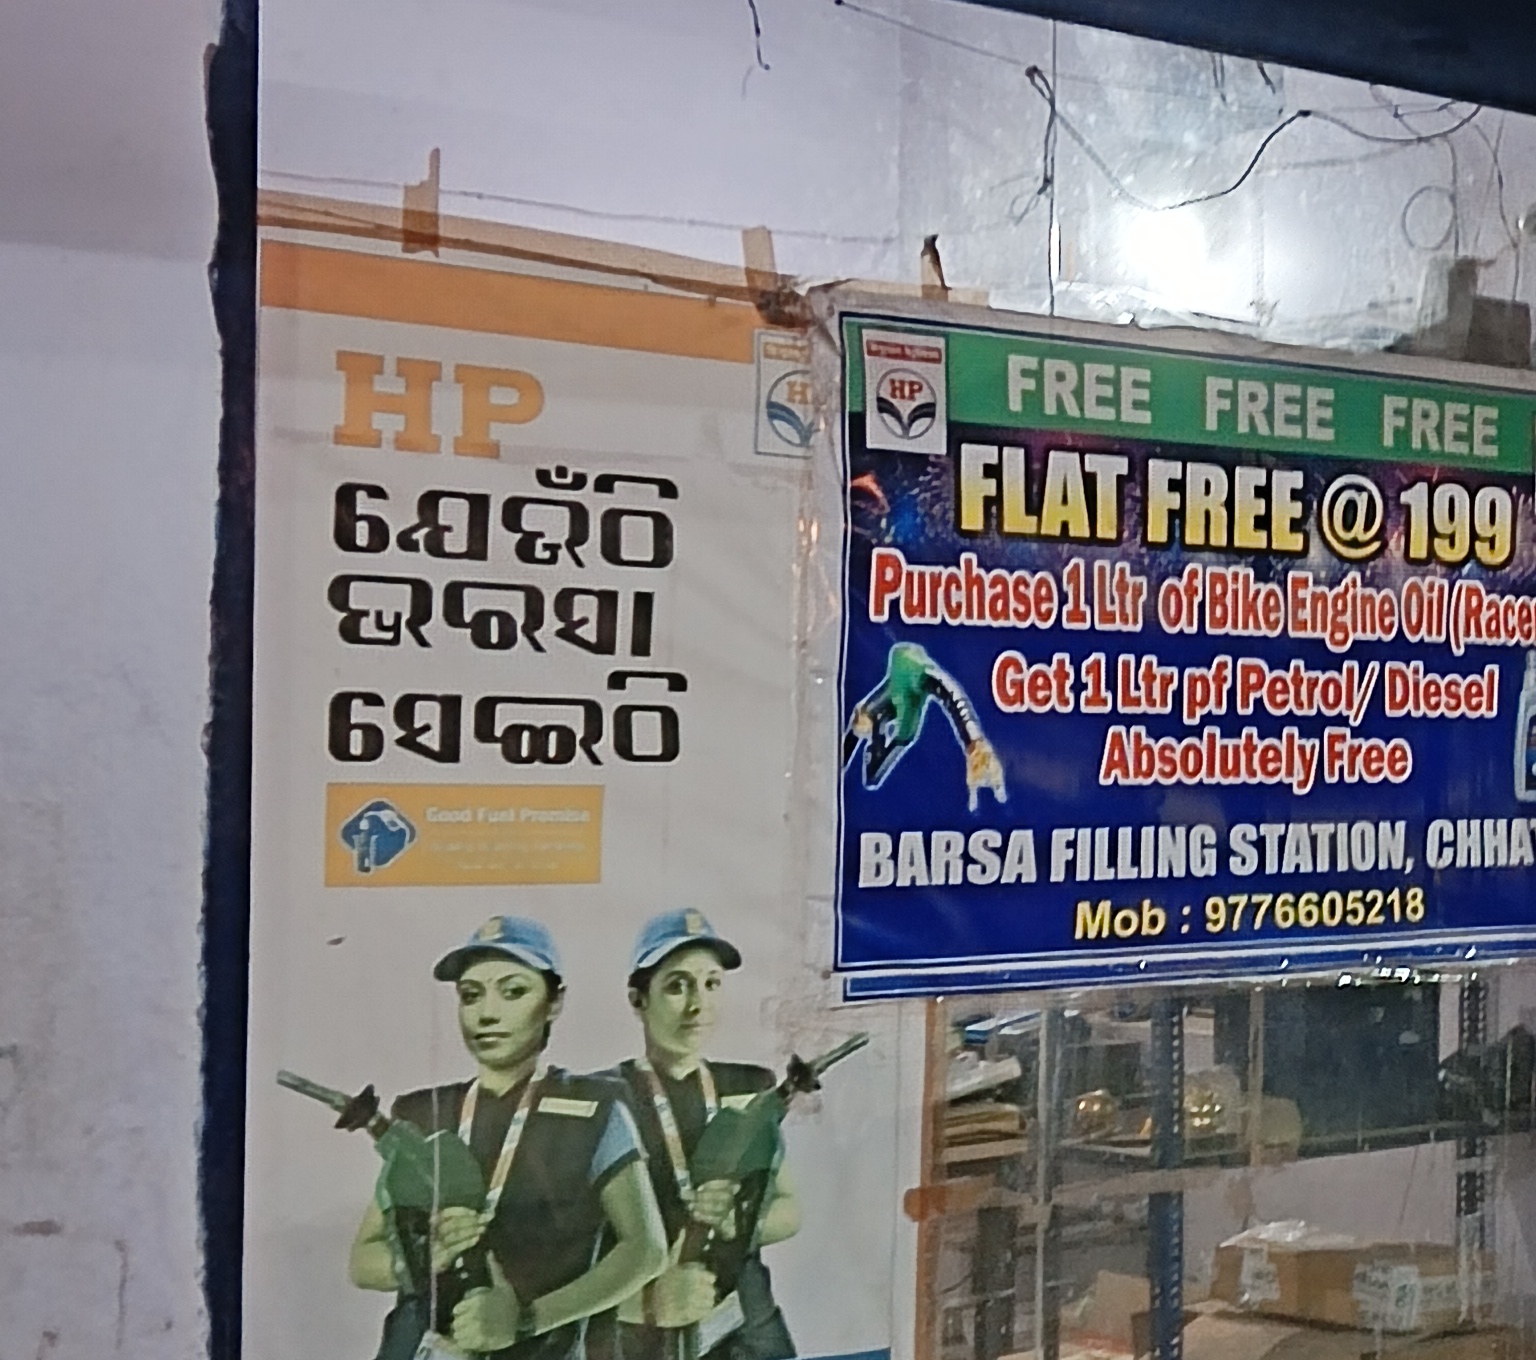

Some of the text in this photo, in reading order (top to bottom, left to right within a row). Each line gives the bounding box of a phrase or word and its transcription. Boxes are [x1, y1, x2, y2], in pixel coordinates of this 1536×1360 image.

[334, 350, 545, 459] HP
[889, 378, 924, 402] HP
[1007, 353, 1499, 458] FREE FREE FREE
[333, 465, 679, 569] ଯେଉଁଠି
[959, 443, 1516, 564] FLAT FREE @ 199
[327, 573, 655, 657] ଭରସା
[870, 548, 1057, 624] Purchase
[1063, 559, 1086, 624] 1
[1091, 561, 1144, 627] Ltr
[1161, 565, 1202, 632] of
[1206, 569, 1282, 637] Bike
[1287, 571, 1397, 651] Engine
[1403, 580, 1446, 641] Oil
[327, 670, 688, 766] ସେଇଠି
[991, 650, 1499, 725] Get 1 Ltr pf Petrol/ Diesel
[1098, 726, 1412, 793] Absolutely Free
[858, 828, 1037, 890] BARSA
[1050, 824, 1218, 883] FILLING
[1228, 820, 1416, 875] STATION,
[1074, 887, 1426, 941] Mob : 9776605218
